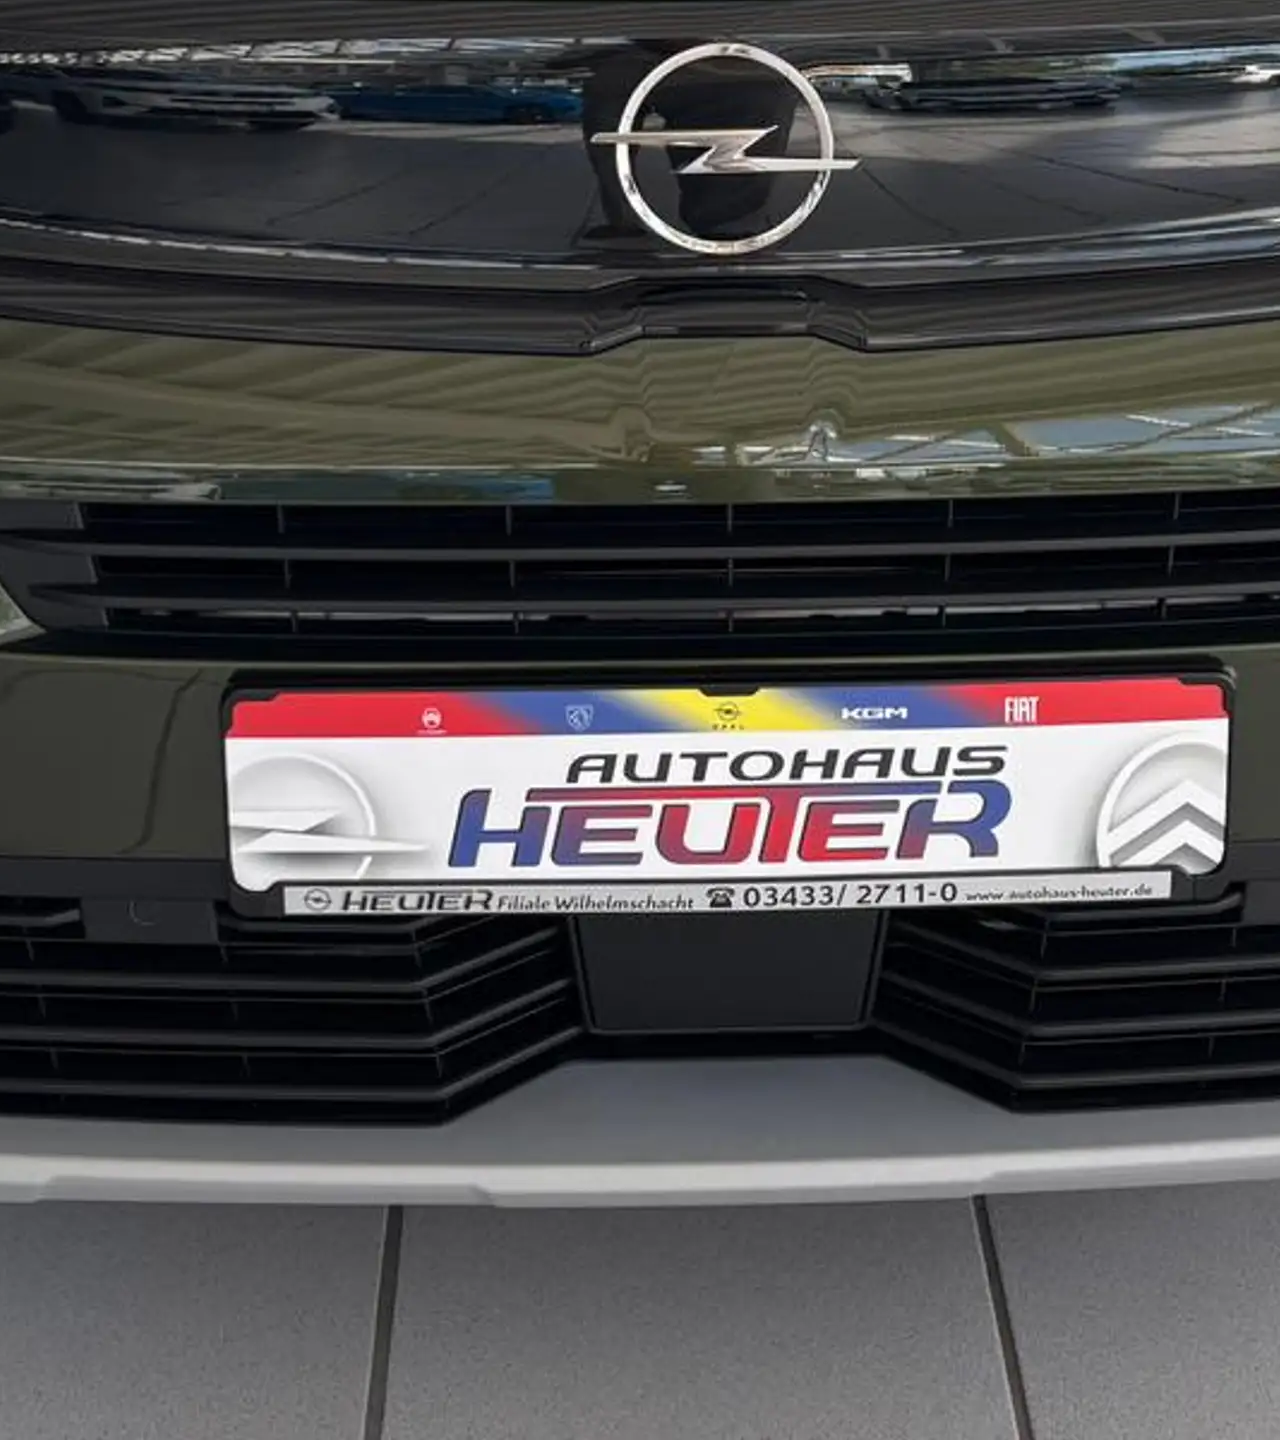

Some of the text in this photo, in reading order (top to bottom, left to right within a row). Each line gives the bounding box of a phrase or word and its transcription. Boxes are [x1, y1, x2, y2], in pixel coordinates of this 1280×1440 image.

[841, 705, 908, 720] KGM
[1004, 696, 1039, 724] FIAT
[566, 745, 1008, 784] AUTOHAUS
[448, 779, 1012, 868] HEUTER
[342, 889, 494, 911] HEUTER
[497, 895, 550, 911] Filiale
[554, 895, 694, 911] Wilhelmschacht
[743, 883, 846, 907] 03433/
[855, 882, 958, 904] 2711-0
